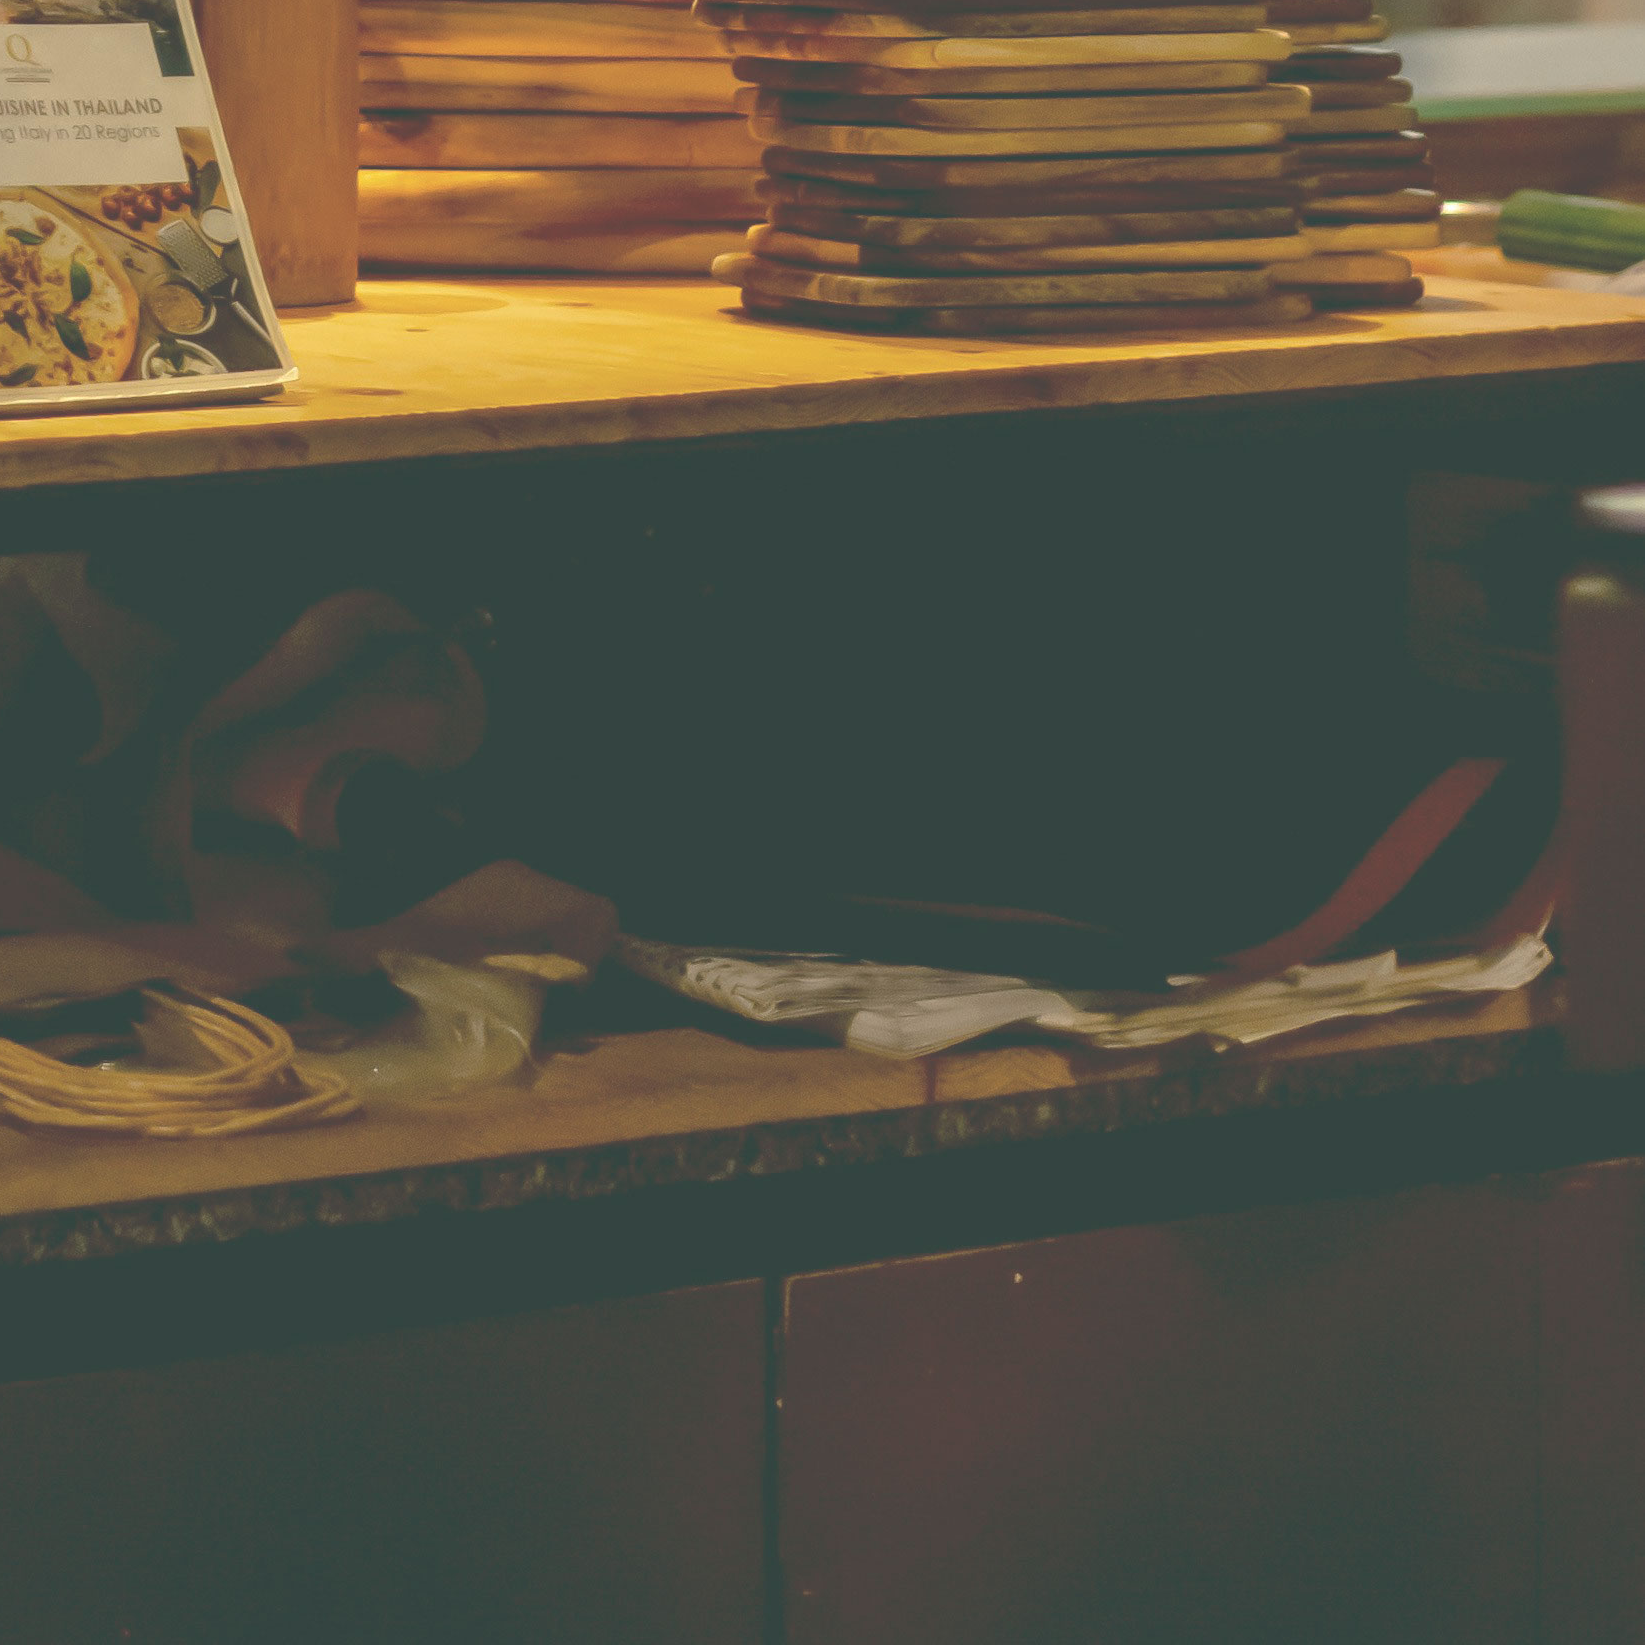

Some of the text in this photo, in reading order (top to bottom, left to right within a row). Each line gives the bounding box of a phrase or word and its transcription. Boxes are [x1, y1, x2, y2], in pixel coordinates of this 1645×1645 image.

[51, 99, 70, 116] IN
[73, 97, 163, 116] THAILAND
[19, 125, 52, 143] Italy
[55, 126, 70, 141] in
[73, 124, 92, 141] 20
[97, 124, 161, 144] Regions
